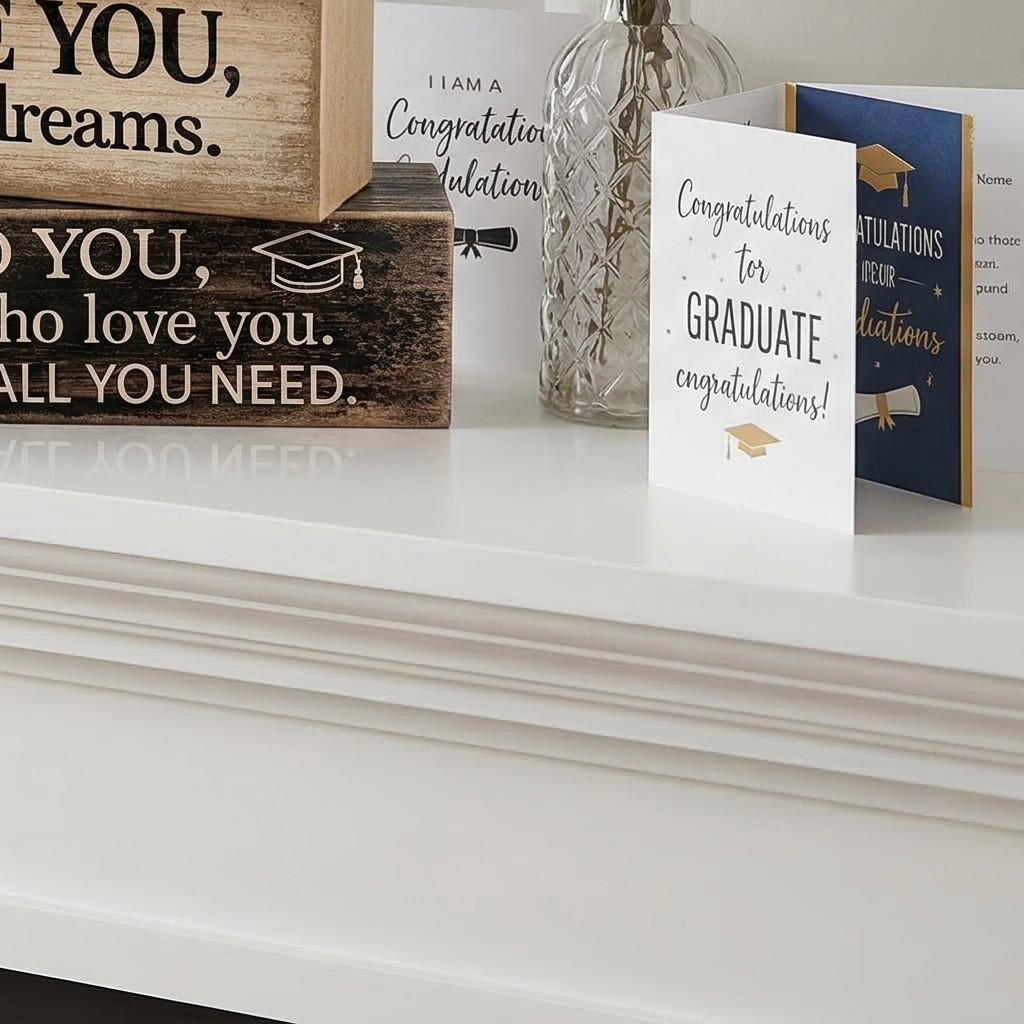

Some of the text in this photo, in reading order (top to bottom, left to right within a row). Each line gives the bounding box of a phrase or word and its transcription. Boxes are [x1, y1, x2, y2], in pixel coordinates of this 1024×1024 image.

[36, 0, 240, 98] YOU,
[677, 178, 831, 243] Congratulations
[856, 214, 943, 260] ATULATIONS
[35, 228, 210, 289] YOU,
[84, 294, 196, 346] love
[214, 307, 333, 360] you.
[687, 291, 822, 365] GRADUATE
[94, 363, 192, 405] YOU
[212, 364, 358, 407] NEED.
[975, 355, 1002, 366] you.
